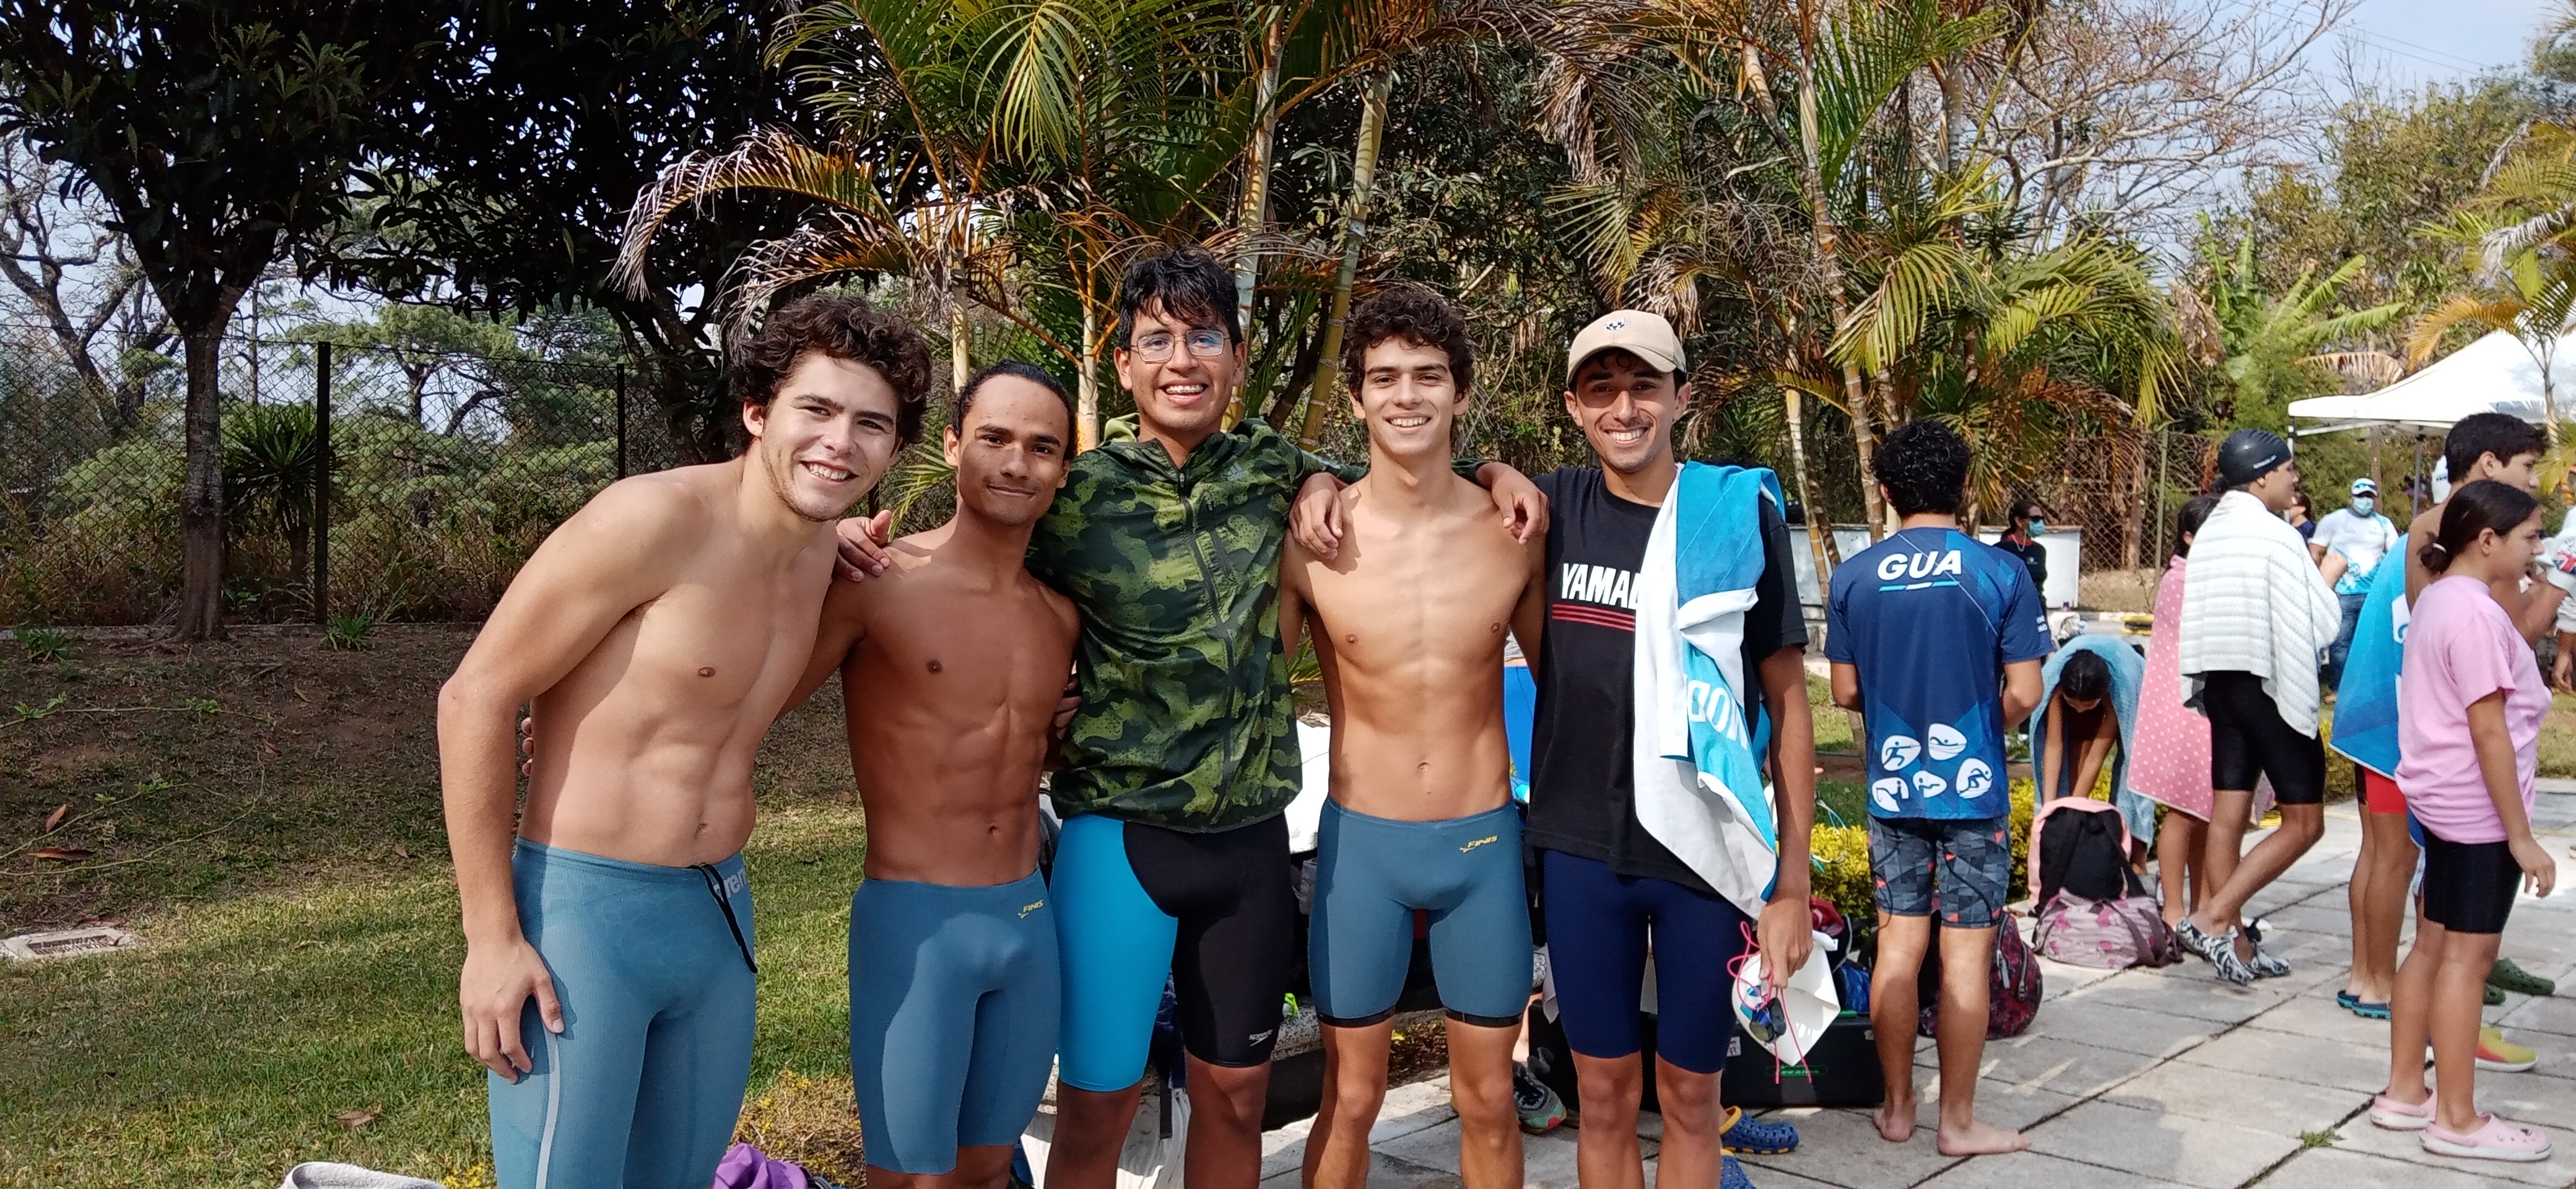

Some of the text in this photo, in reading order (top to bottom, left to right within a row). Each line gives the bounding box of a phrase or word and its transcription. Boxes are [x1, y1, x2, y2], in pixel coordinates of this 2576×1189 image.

[1878, 550, 1962, 580] GUA
[1467, 835, 1499, 848] FINIS
[1023, 899, 1044, 913] FINIS
